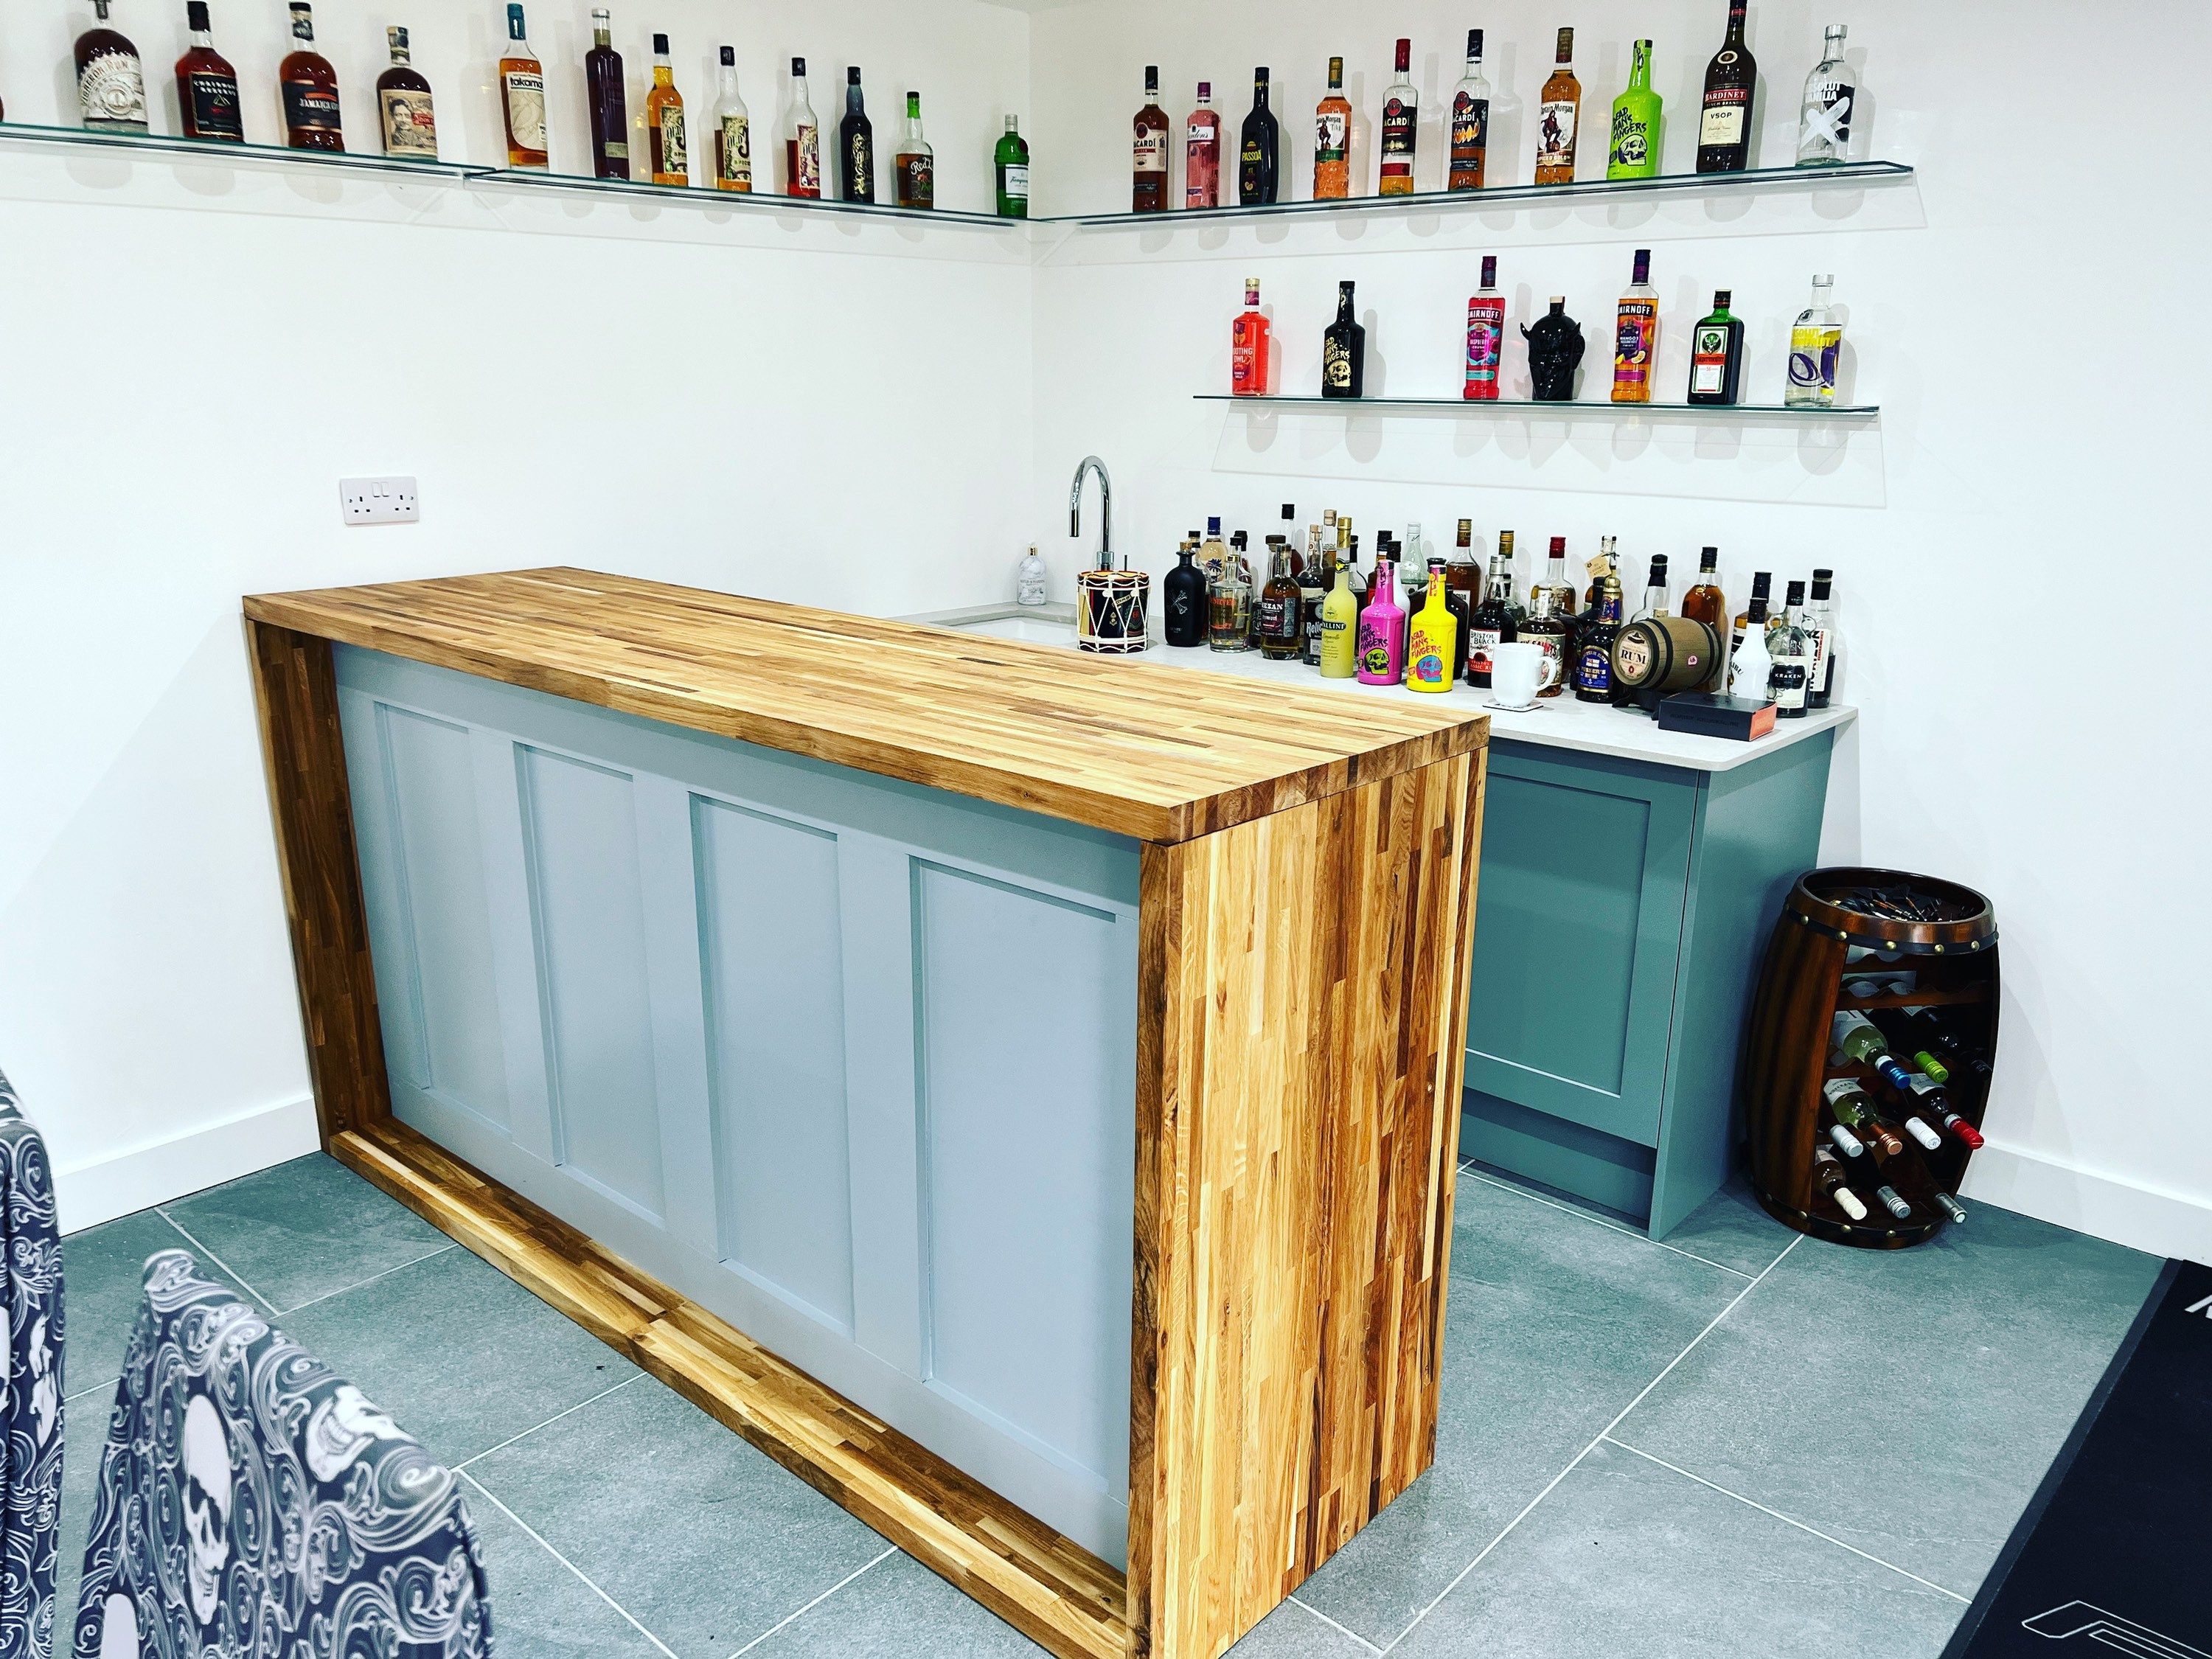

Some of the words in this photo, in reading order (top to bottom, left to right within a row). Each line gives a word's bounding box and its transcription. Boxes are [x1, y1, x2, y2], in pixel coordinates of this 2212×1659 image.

[193, 80, 236, 88] CHAIRMAN
[510, 76, 543, 89] takama
[1704, 91, 1745, 102] BARDINET
[1554, 103, 1573, 114] Morgan
[1383, 116, 1410, 126] ACARDÍ
[1453, 111, 1475, 122] CARDÍ
[1613, 122, 1646, 144] FINGERS
[1134, 138, 1156, 147] ACARDÍ
[1618, 305, 1651, 315] MIRNOFF
[1793, 328, 1823, 339] SOLUT
[1307, 621, 1322, 637] Relic
[1470, 630, 1495, 639] BRISTOL
[1473, 637, 1497, 645] BLACK
[1411, 645, 1441, 659] FINGERS
[1621, 650, 1646, 664] RUM
